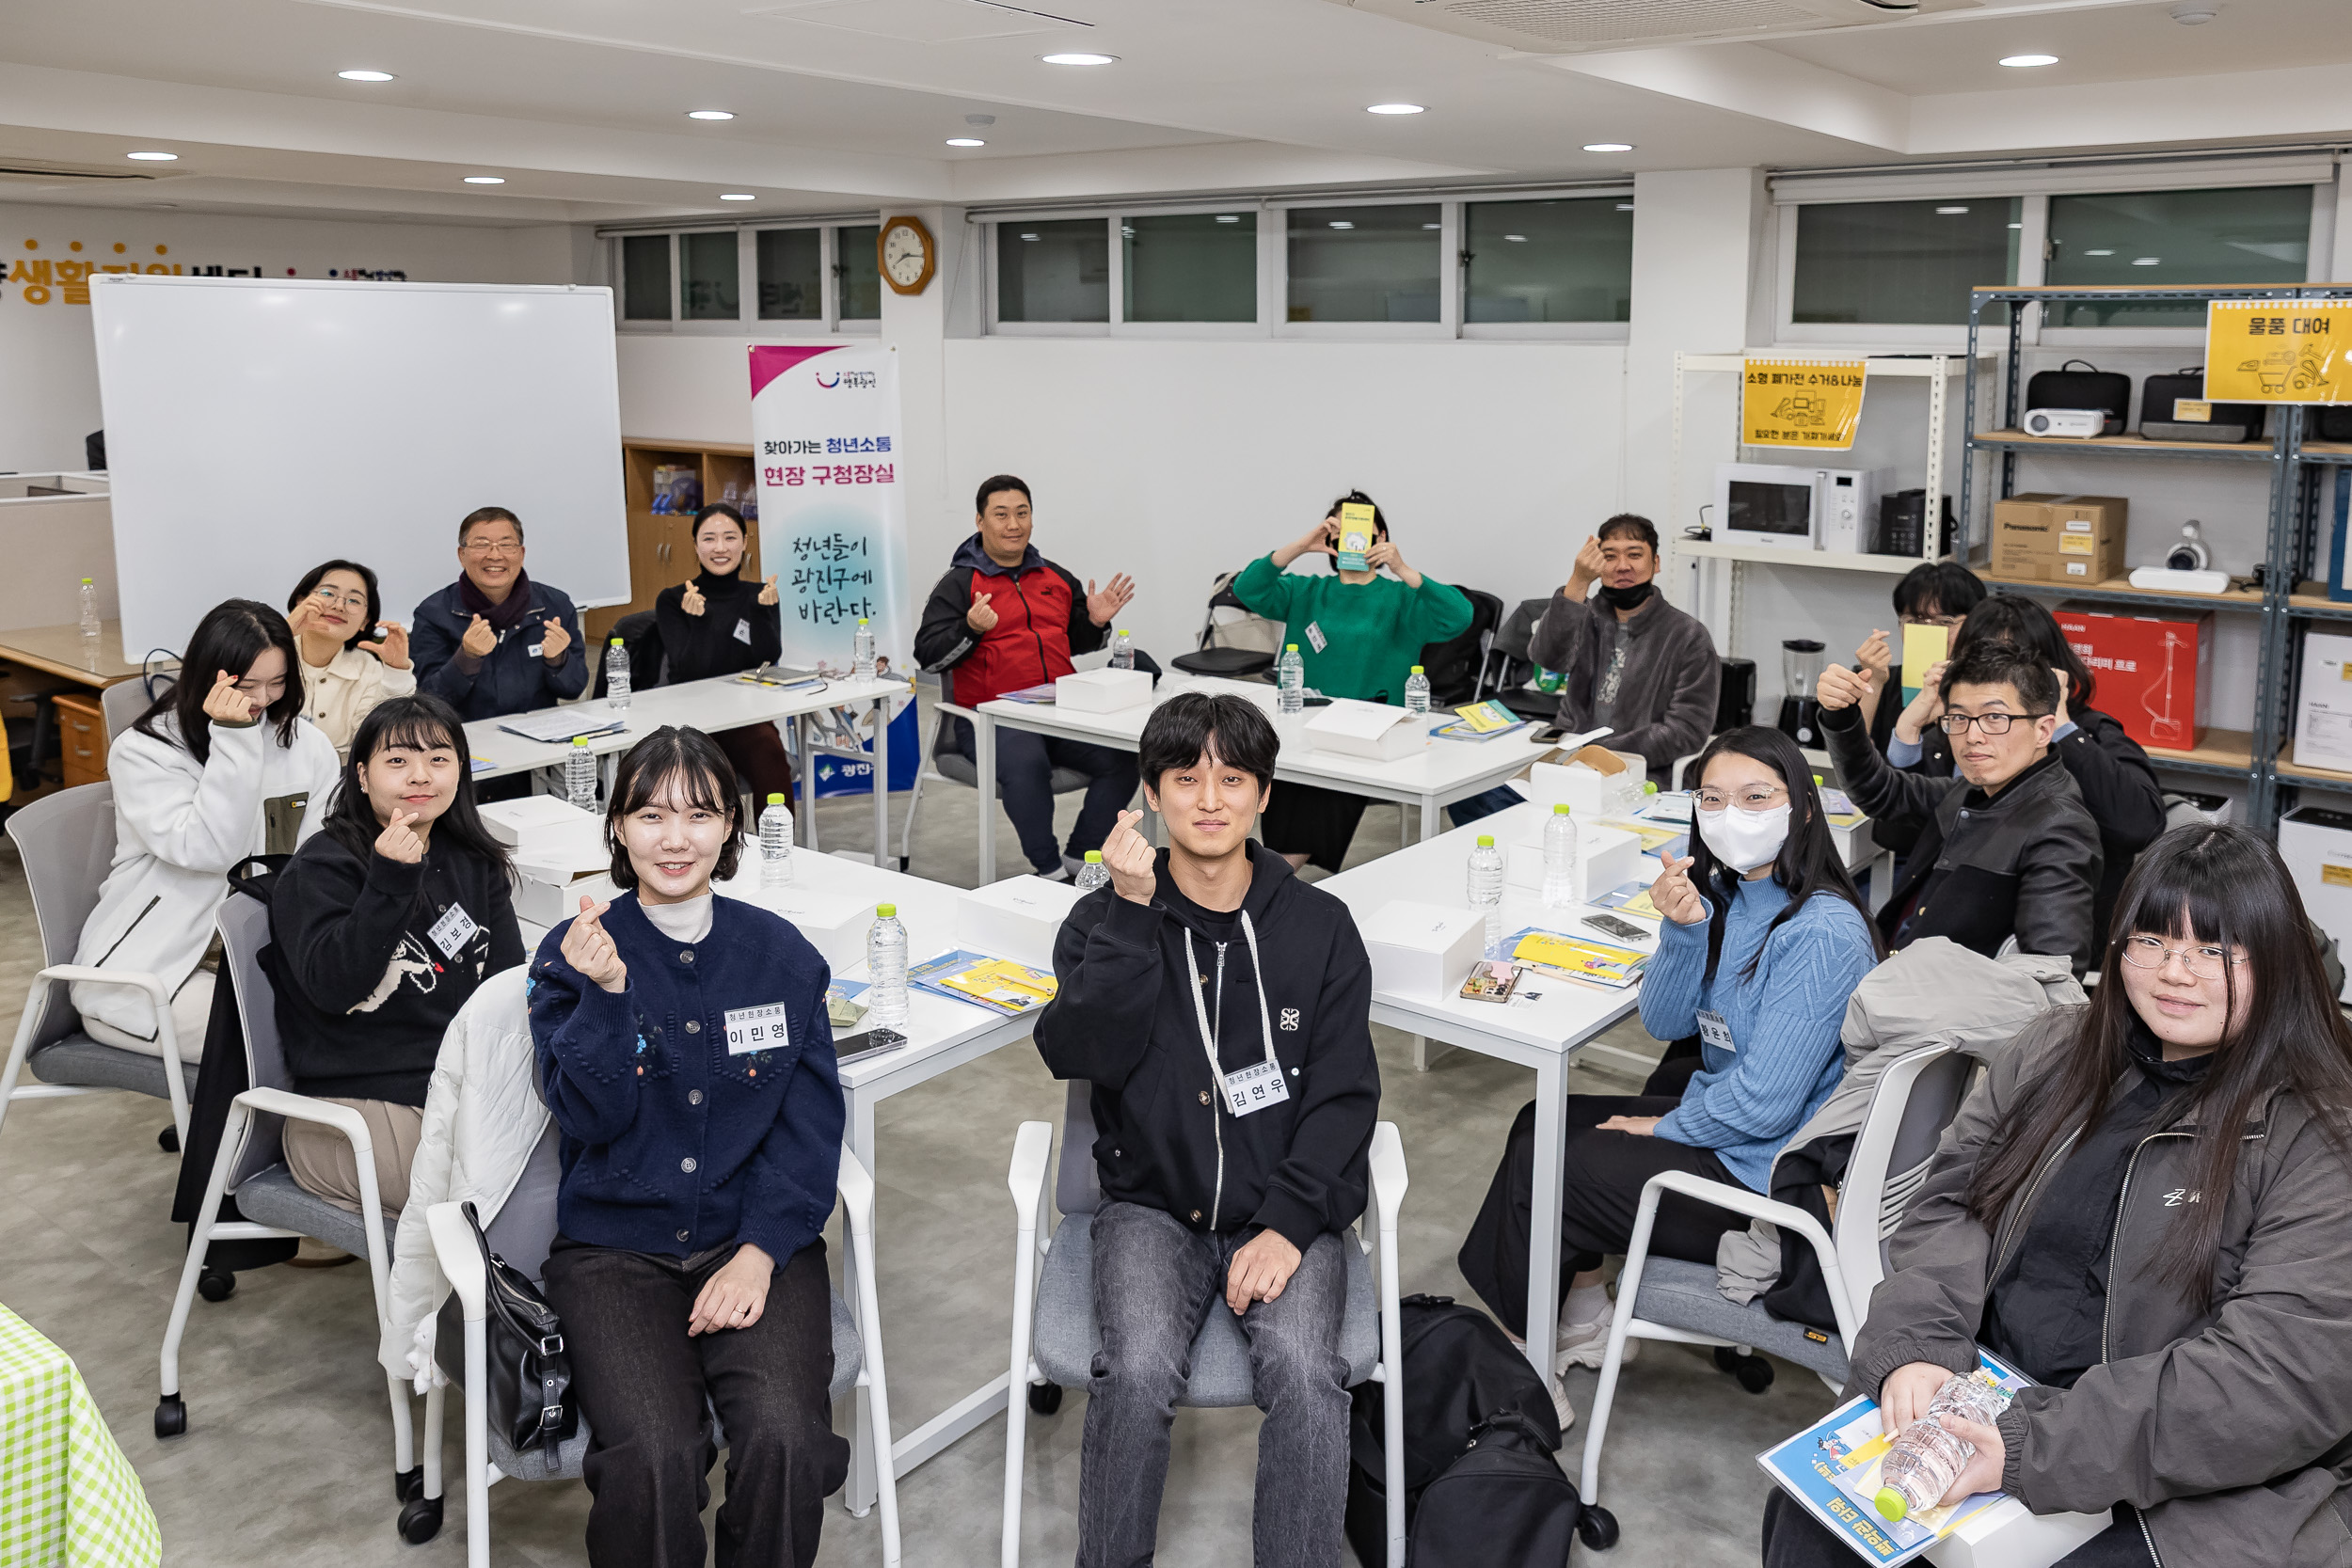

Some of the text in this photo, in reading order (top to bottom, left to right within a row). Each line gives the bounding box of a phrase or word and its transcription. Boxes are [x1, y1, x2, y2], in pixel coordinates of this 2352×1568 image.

[2249, 317, 2329, 335] 물품 대여
[1747, 372, 1768, 385] 소형
[764, 436, 892, 455] 찾아가는 청년소통
[764, 463, 895, 487] 현장 구청장실
[793, 532, 866, 562] 청년들이
[791, 564, 872, 594] 광진구에
[798, 595, 877, 625] 바란다.
[2114, 659, 2137, 673] 프로
[841, 762, 875, 778] 광진
[439, 915, 472, 952] 김보경
[729, 1022, 785, 1044] 이민영
[1232, 1078, 1284, 1108] 김연우
[1825, 1496, 1896, 1557] 백악관 타워
